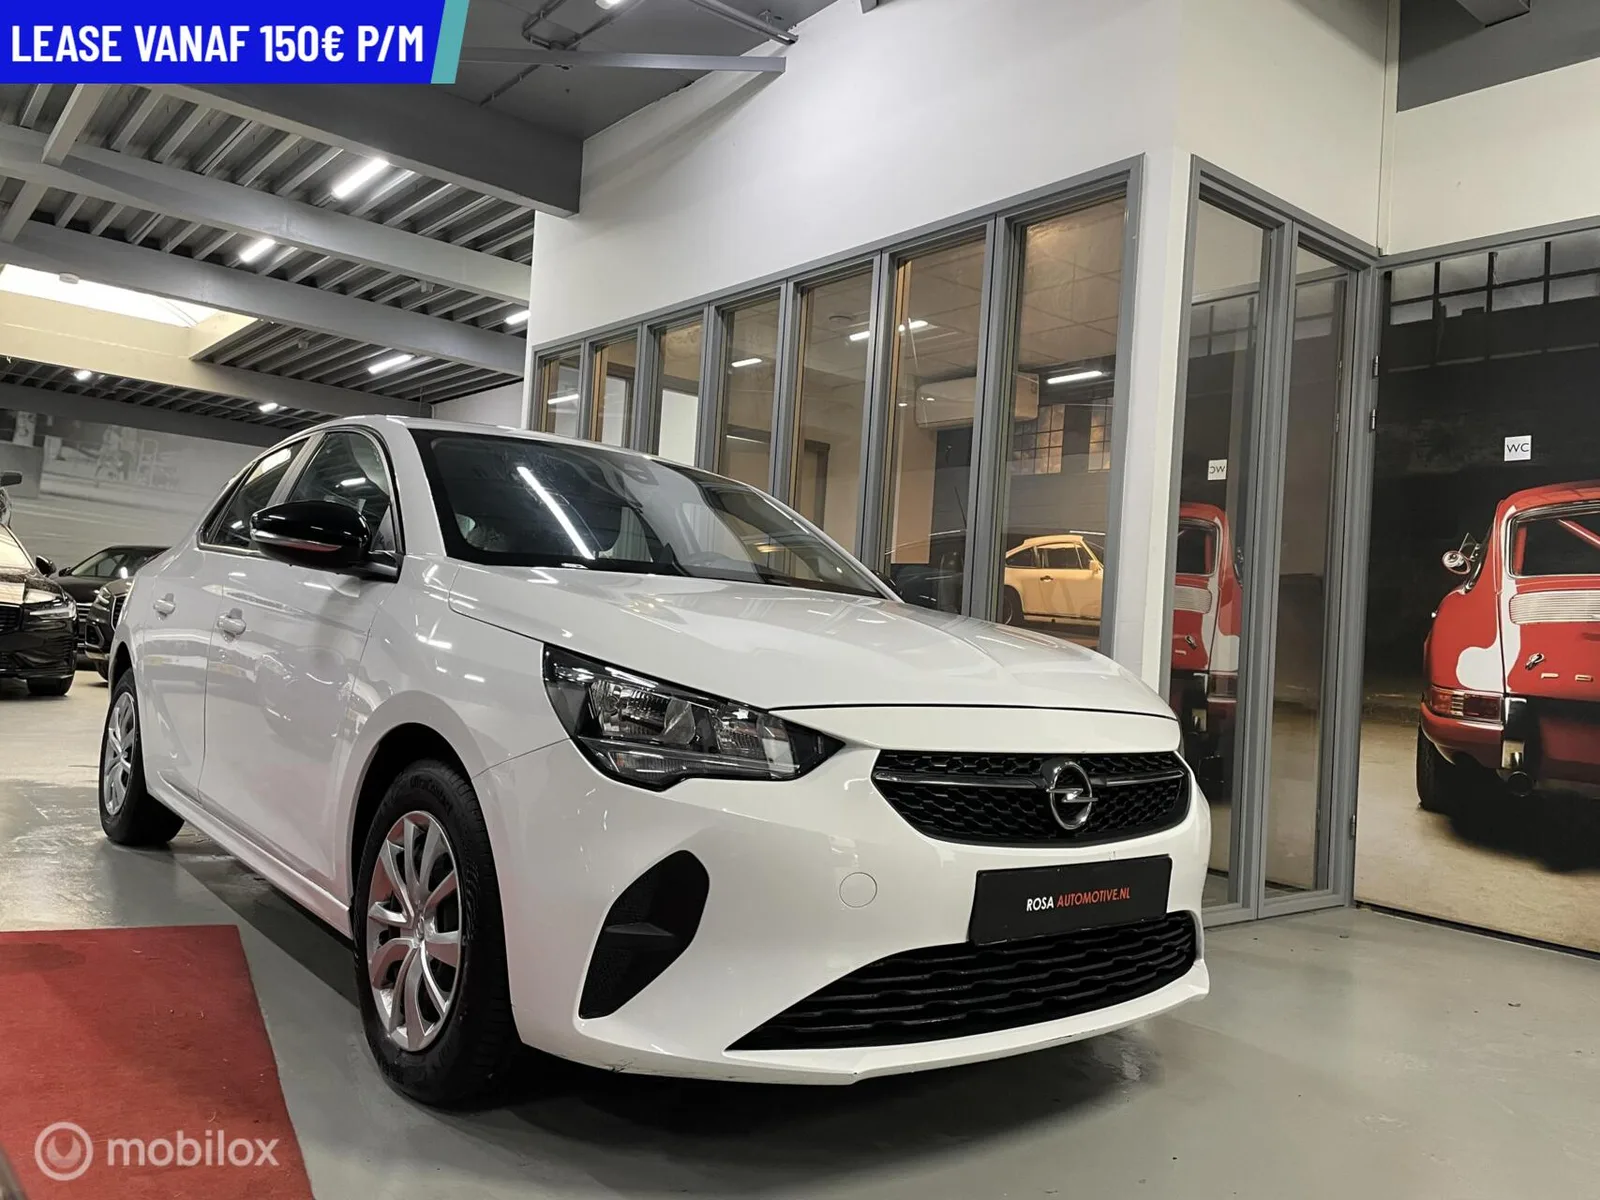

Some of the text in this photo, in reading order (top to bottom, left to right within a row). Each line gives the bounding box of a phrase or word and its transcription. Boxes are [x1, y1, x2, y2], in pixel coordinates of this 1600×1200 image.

[1506, 442, 1530, 453] WC
[1026, 887, 1131, 912] ROSA AUTOMOTIVE.NL
